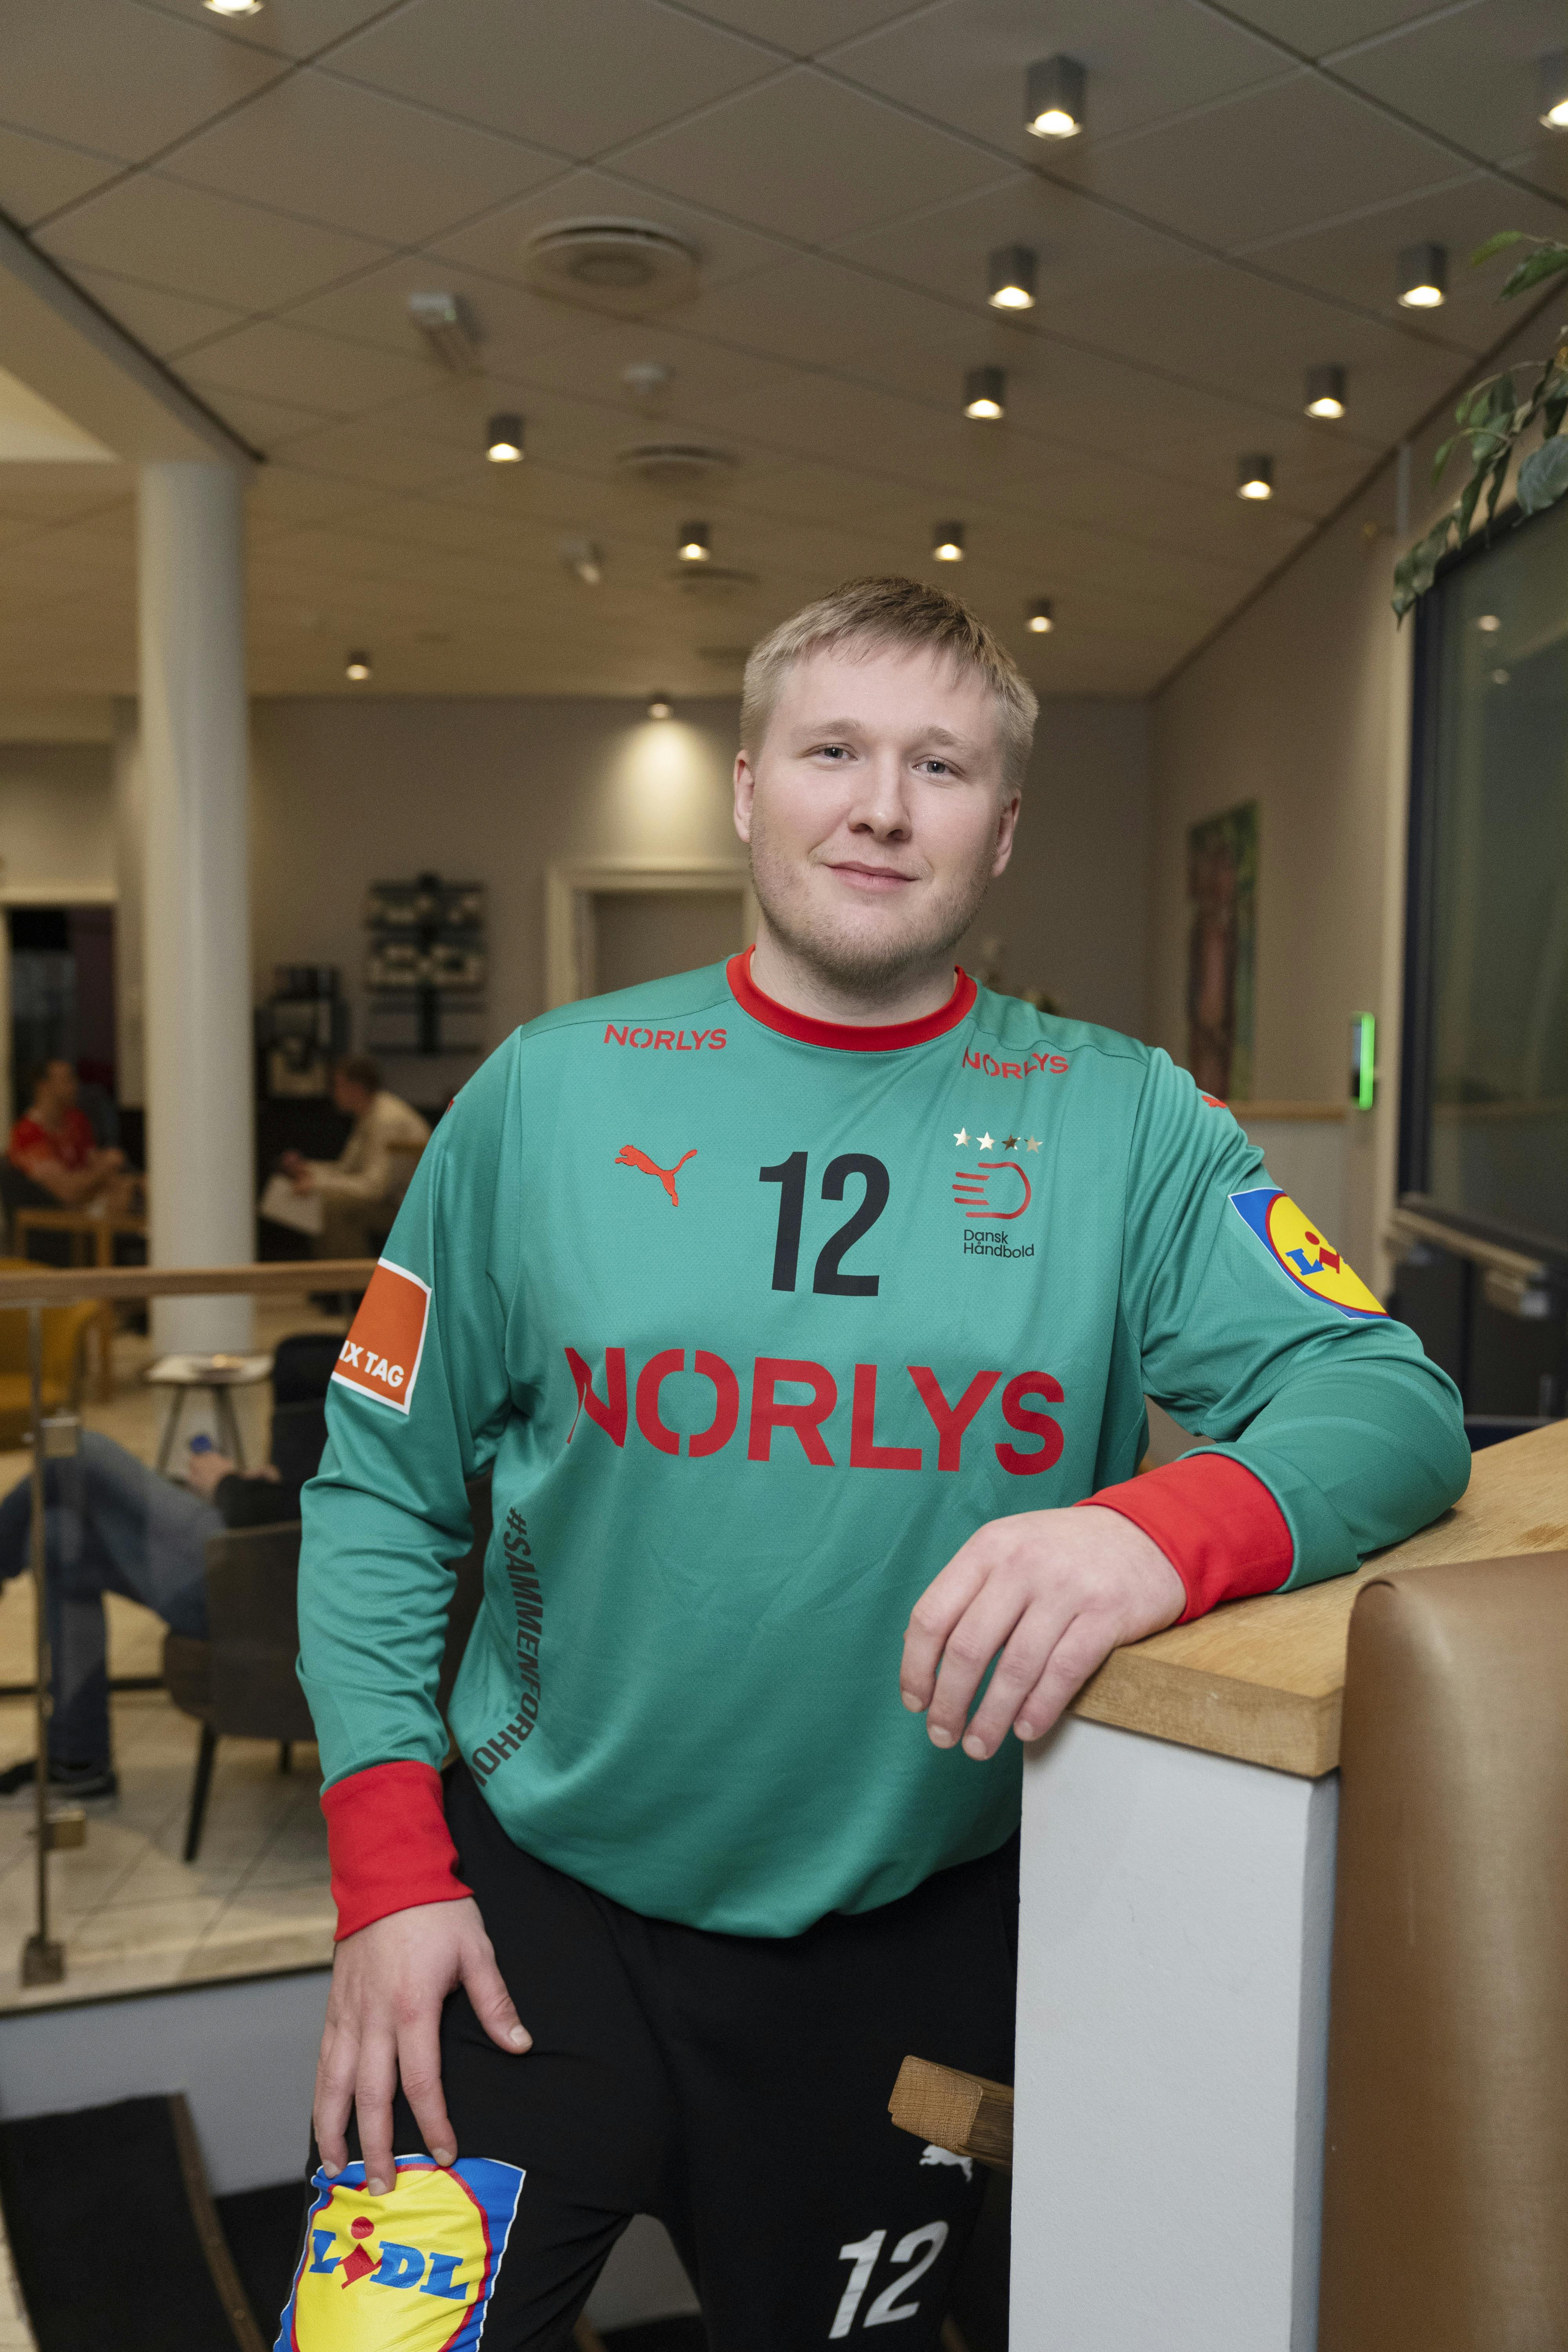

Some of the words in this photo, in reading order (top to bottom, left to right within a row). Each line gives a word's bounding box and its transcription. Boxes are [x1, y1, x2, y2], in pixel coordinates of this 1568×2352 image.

[604, 1024, 727, 1051] NORLYS
[962, 1046, 1069, 1079] NORLYS
[759, 1151, 890, 1296] 12
[964, 1229, 1009, 1245] Dansk
[963, 1241, 1034, 1258] Håndbold
[364, 1351, 405, 1387] TAG
[564, 1347, 1065, 1476] NORLYS
[828, 2220, 949, 2339] 12
